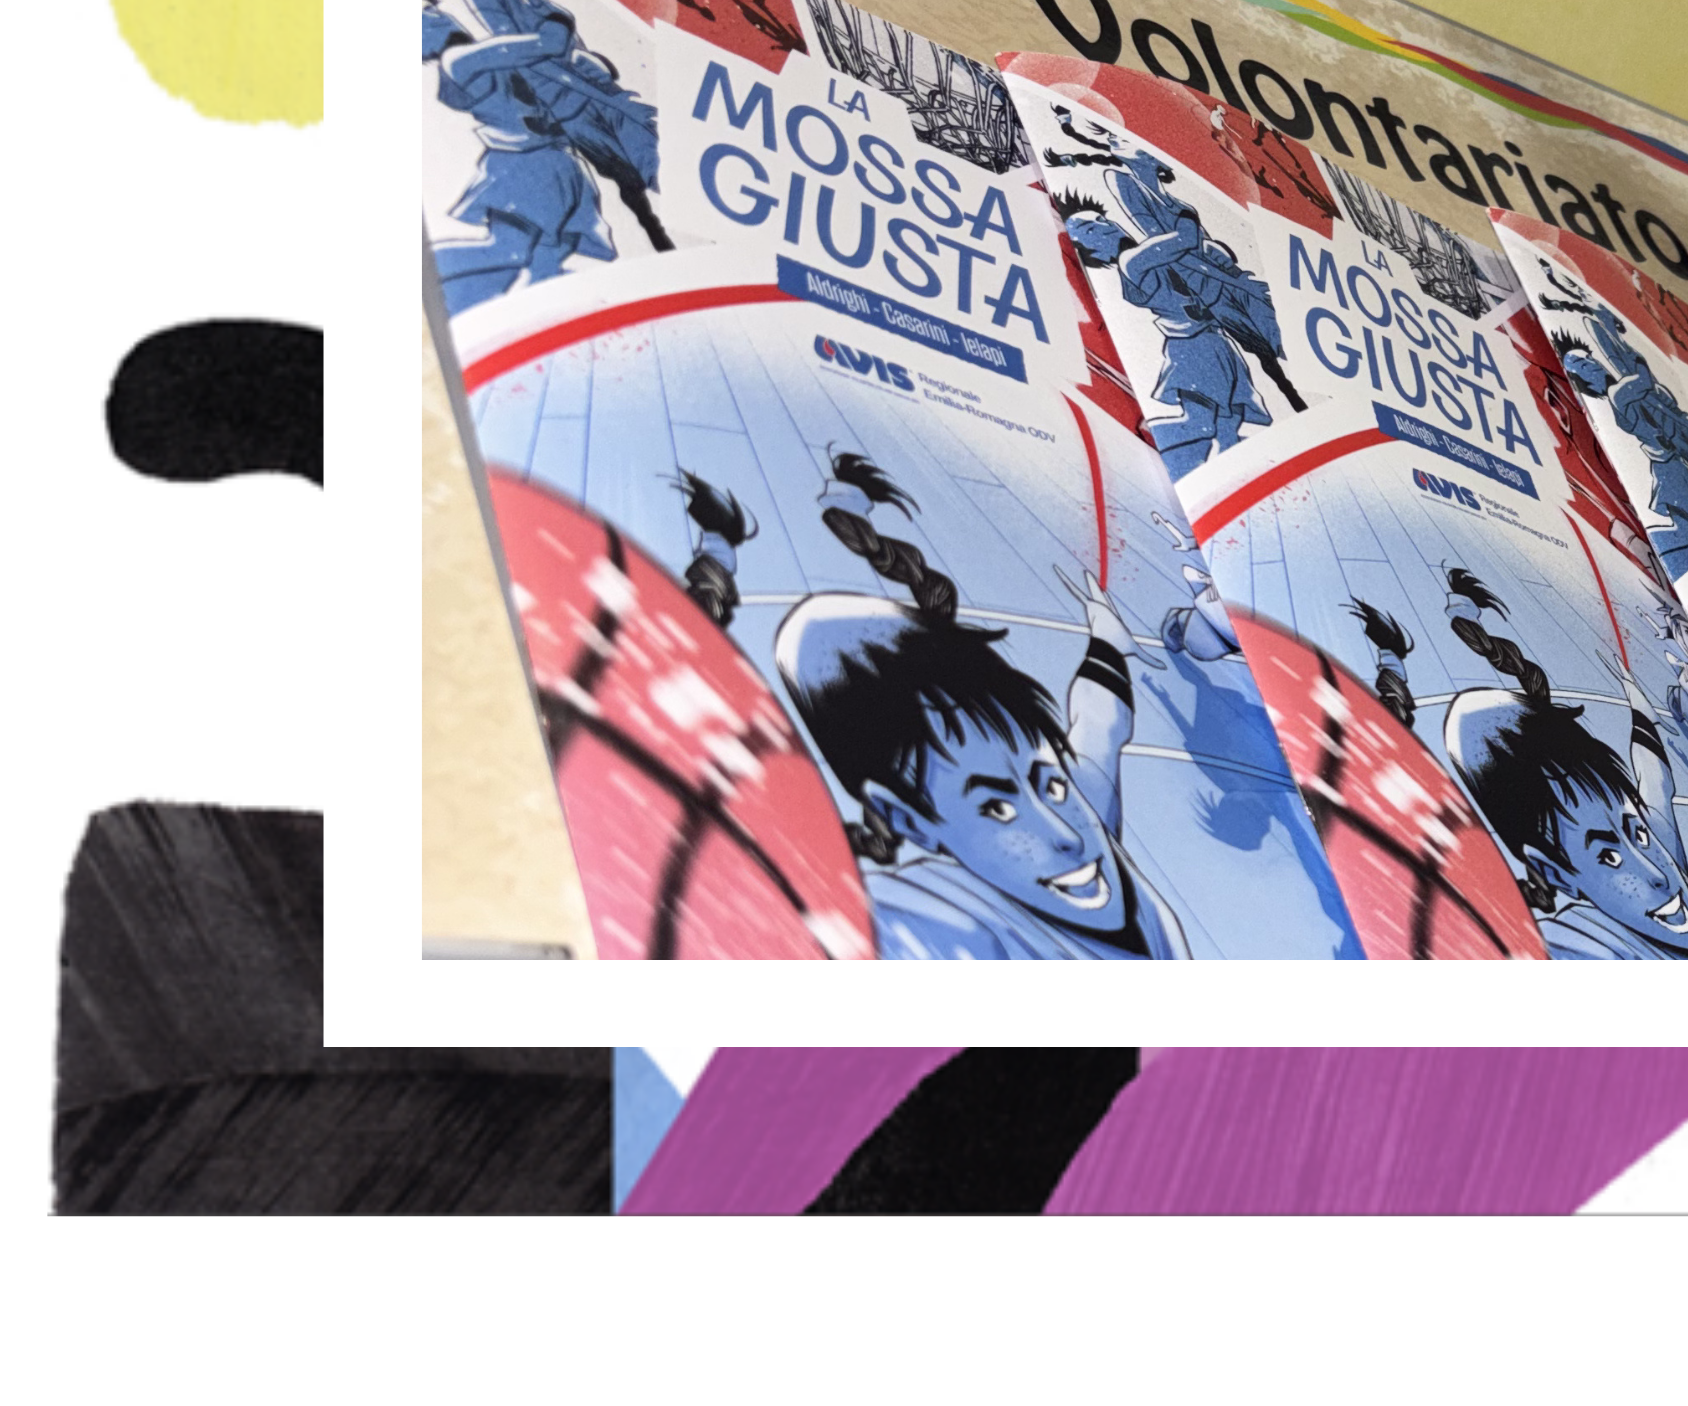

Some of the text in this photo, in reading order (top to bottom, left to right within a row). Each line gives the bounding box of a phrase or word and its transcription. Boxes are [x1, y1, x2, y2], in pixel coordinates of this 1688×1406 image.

[828, 78, 871, 122] LA
[692, 60, 1024, 257] MOSSA
[699, 143, 1050, 344] GIUSTA
[1361, 240, 1393, 277] LA
[806, 271, 871, 315] Aldrighi
[881, 301, 951, 345] Casarini
[1289, 234, 1507, 391] MOSSA
[813, 334, 915, 393] AVIS
[1305, 307, 1544, 467] GIUSTA
[1412, 467, 1482, 511] AVIS
